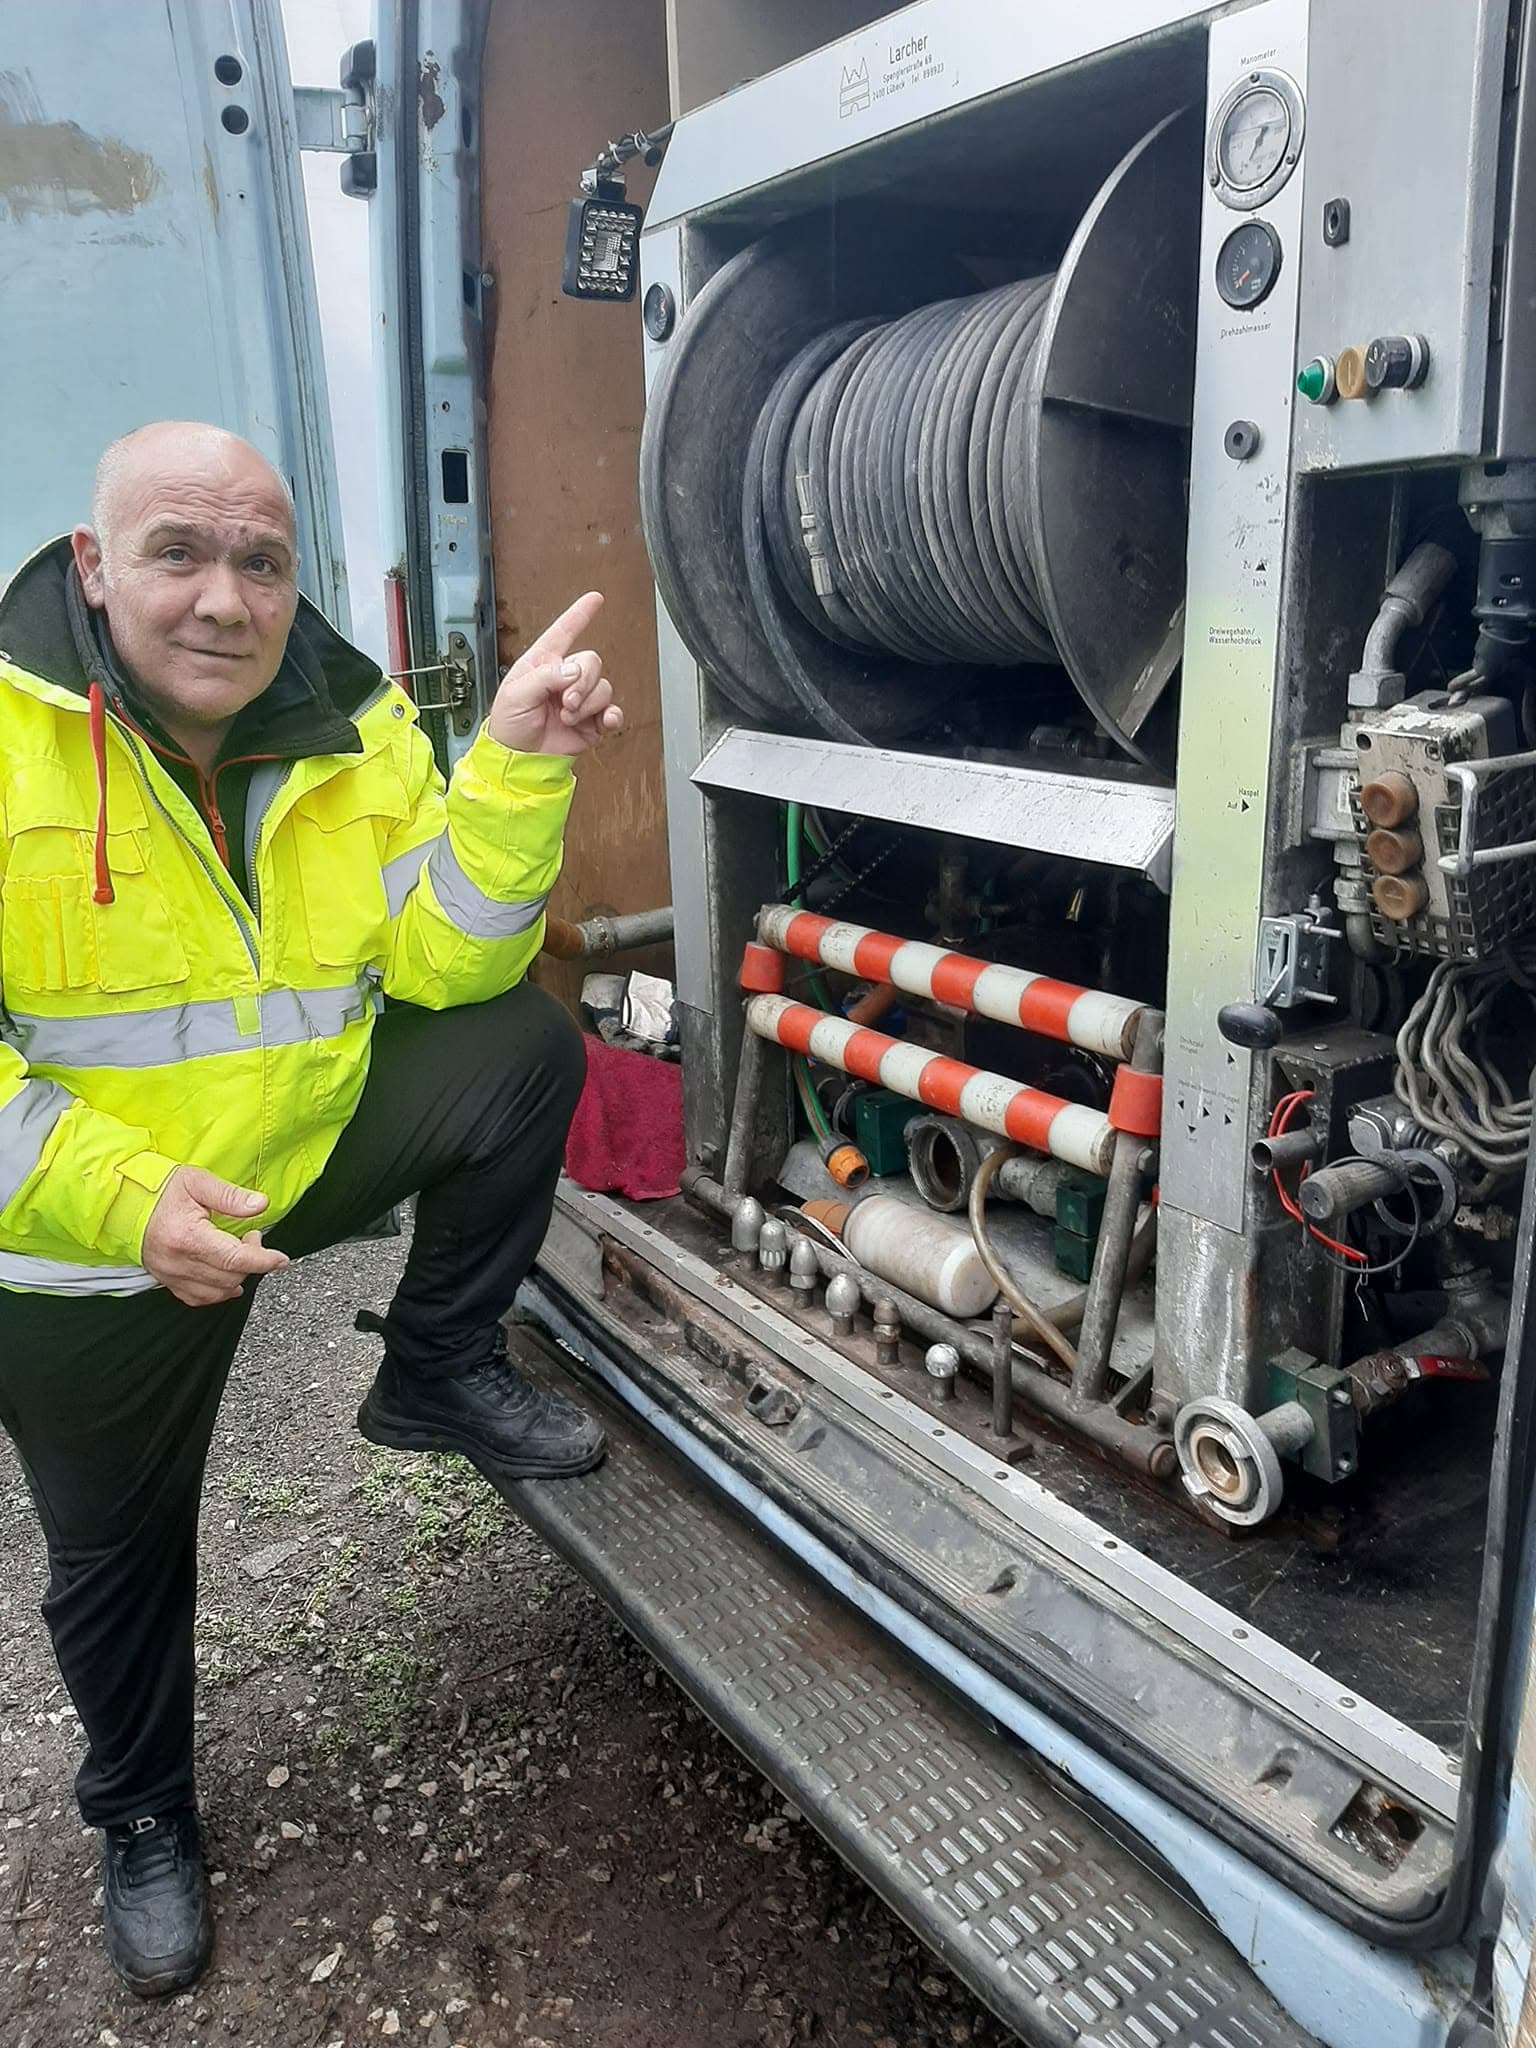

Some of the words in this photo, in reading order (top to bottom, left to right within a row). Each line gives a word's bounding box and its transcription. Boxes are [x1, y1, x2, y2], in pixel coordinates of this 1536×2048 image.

[889, 35, 928, 64] Larcher
[1240, 48, 1277, 66] Manometer
[886, 80, 905, 95] Lübeck
[1220, 322, 1272, 340] Drehzahlmesser
[1209, 626, 1255, 639] Dreiwegehahn/
[1209, 635, 1261, 645] Wasserhochdruck
[1238, 787, 1260, 798] Haspel
